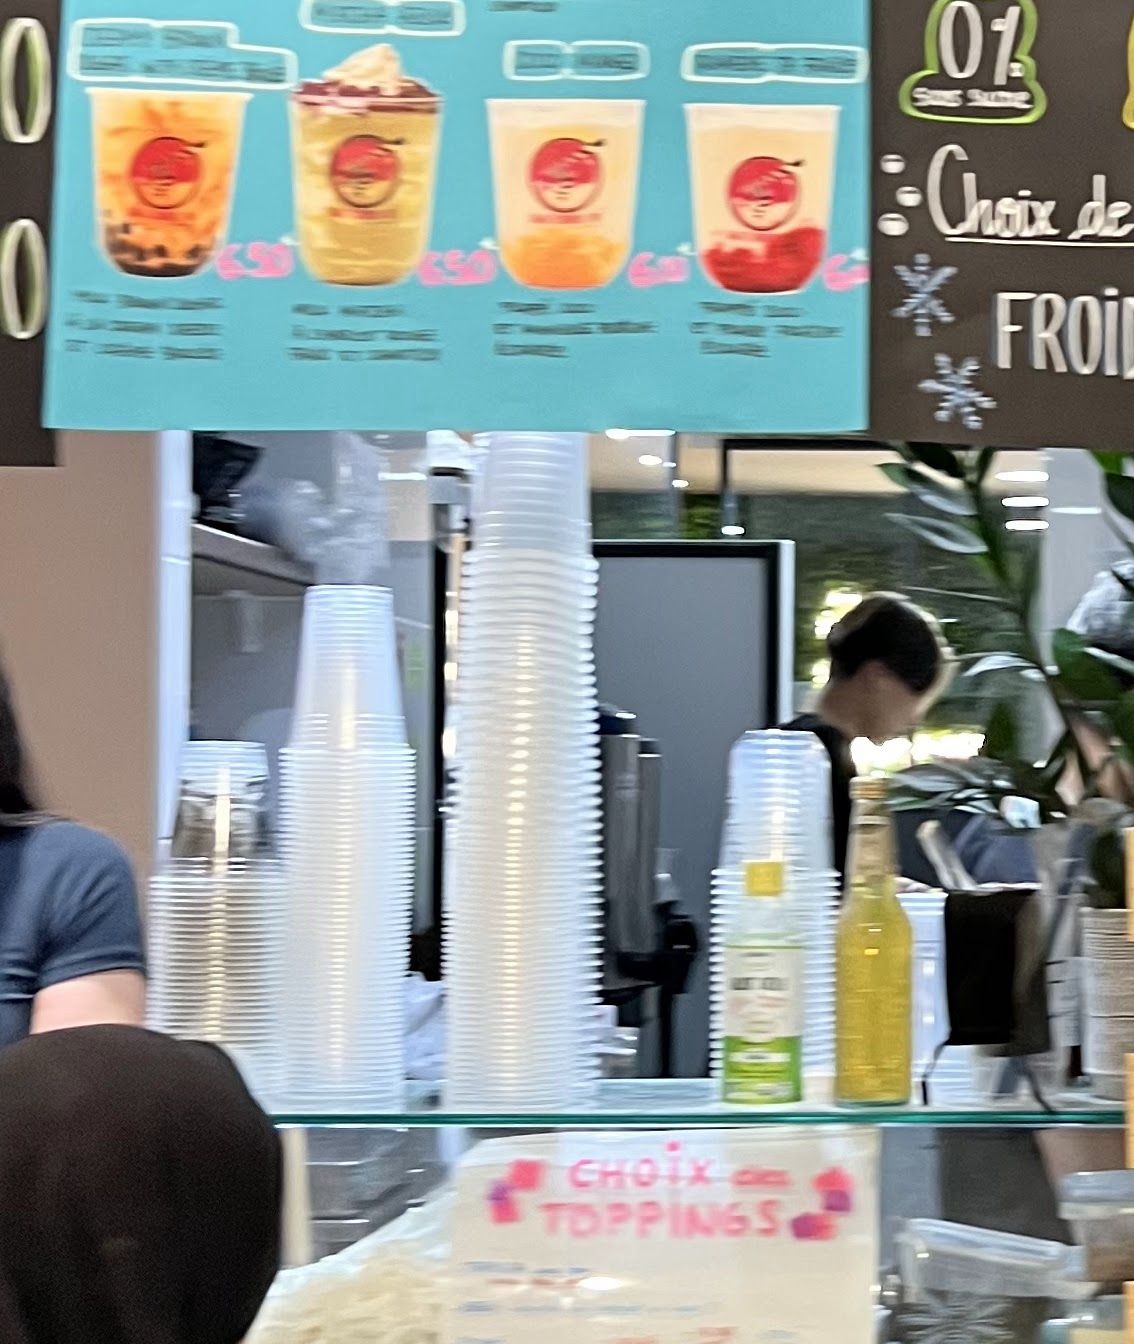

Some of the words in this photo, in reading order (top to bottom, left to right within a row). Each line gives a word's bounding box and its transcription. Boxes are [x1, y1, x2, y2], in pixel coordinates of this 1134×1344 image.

[939, 0, 1030, 85] 0%
[926, 144, 1062, 239] Choix
[539, 1199, 783, 1240] TOPPINGS
